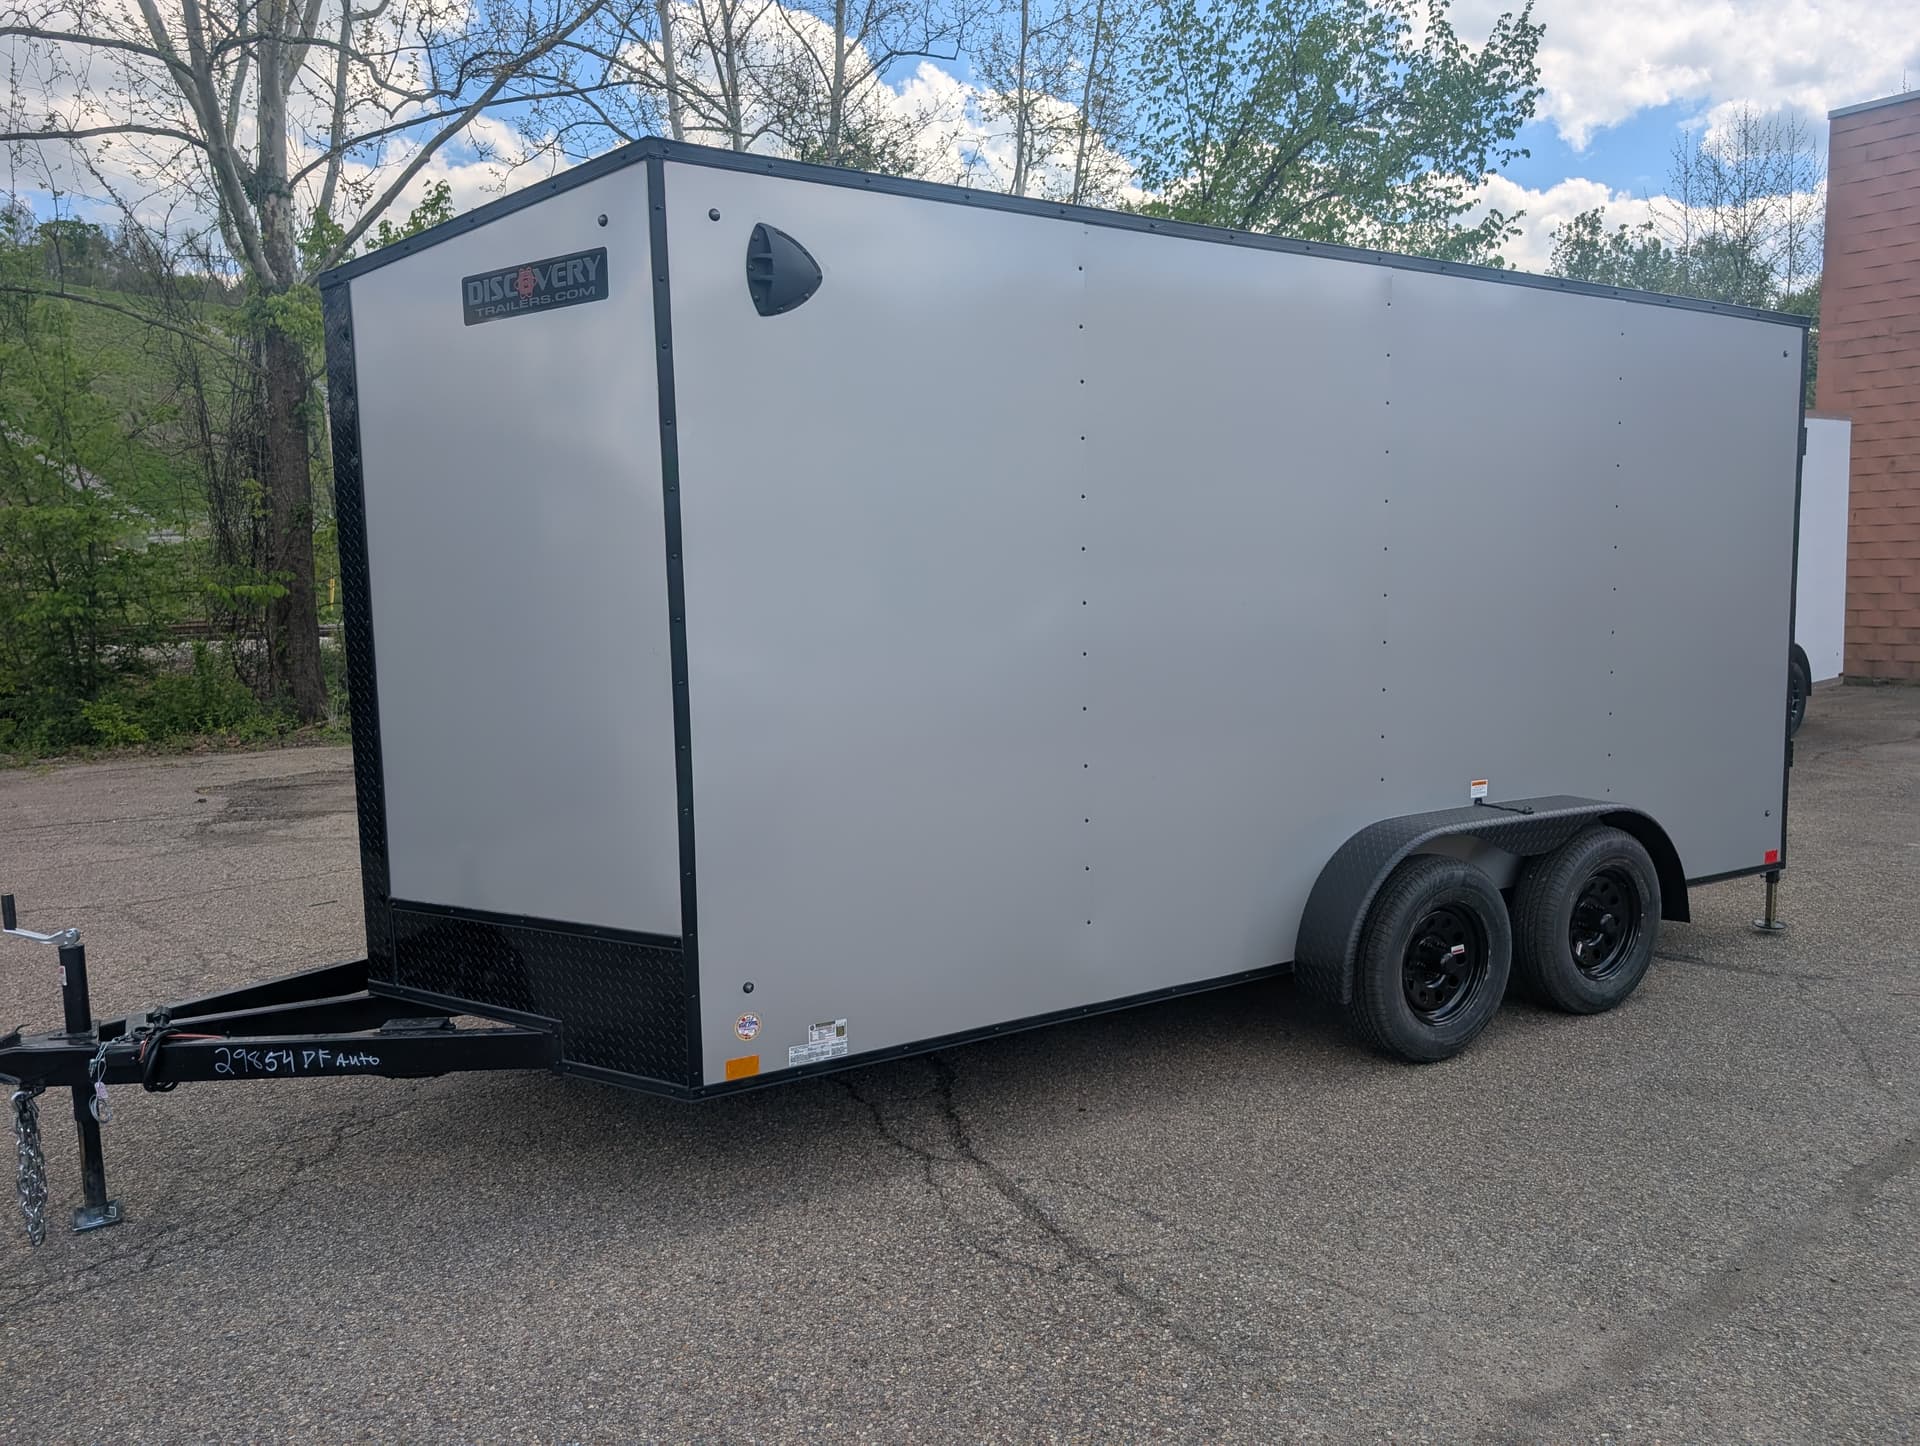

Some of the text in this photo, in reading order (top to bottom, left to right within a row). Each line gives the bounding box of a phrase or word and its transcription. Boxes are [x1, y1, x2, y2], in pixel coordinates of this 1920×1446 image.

[467, 255, 601, 306] DISCOVERY
[476, 286, 596, 317] TRAILERS.COM
[214, 1047, 295, 1075] 29854
